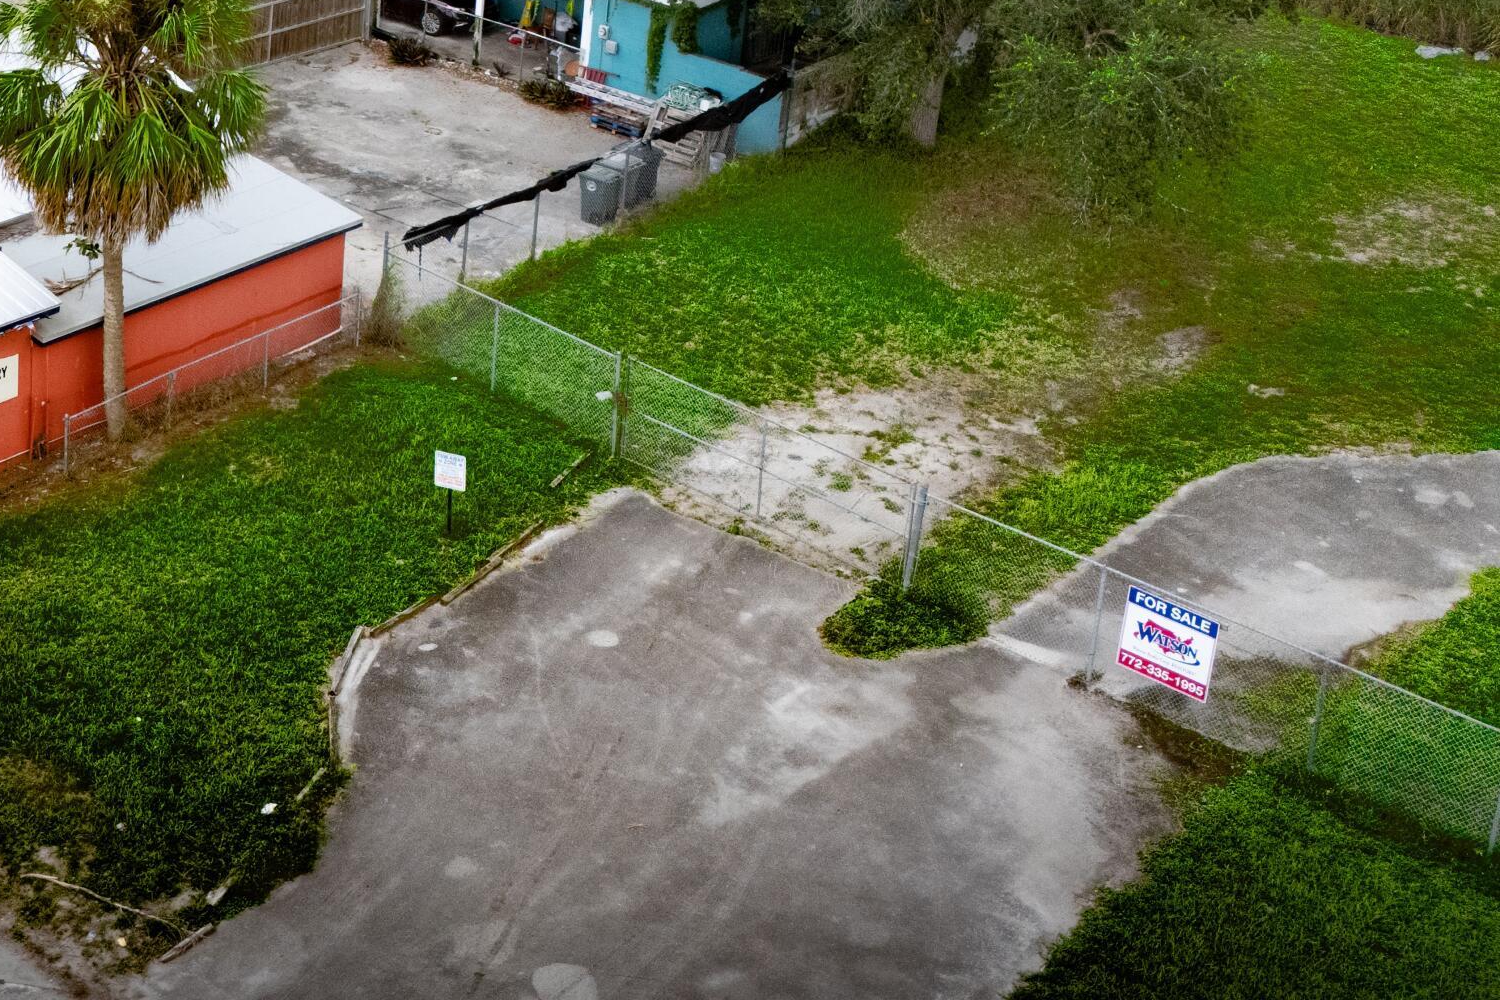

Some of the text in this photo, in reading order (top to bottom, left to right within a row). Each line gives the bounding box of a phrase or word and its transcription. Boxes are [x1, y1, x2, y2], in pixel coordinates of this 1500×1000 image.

[1135, 591, 1211, 633] FOR SALE
[1137, 620, 1198, 659] WATSON
[1121, 652, 1204, 697] 772-335-1995
